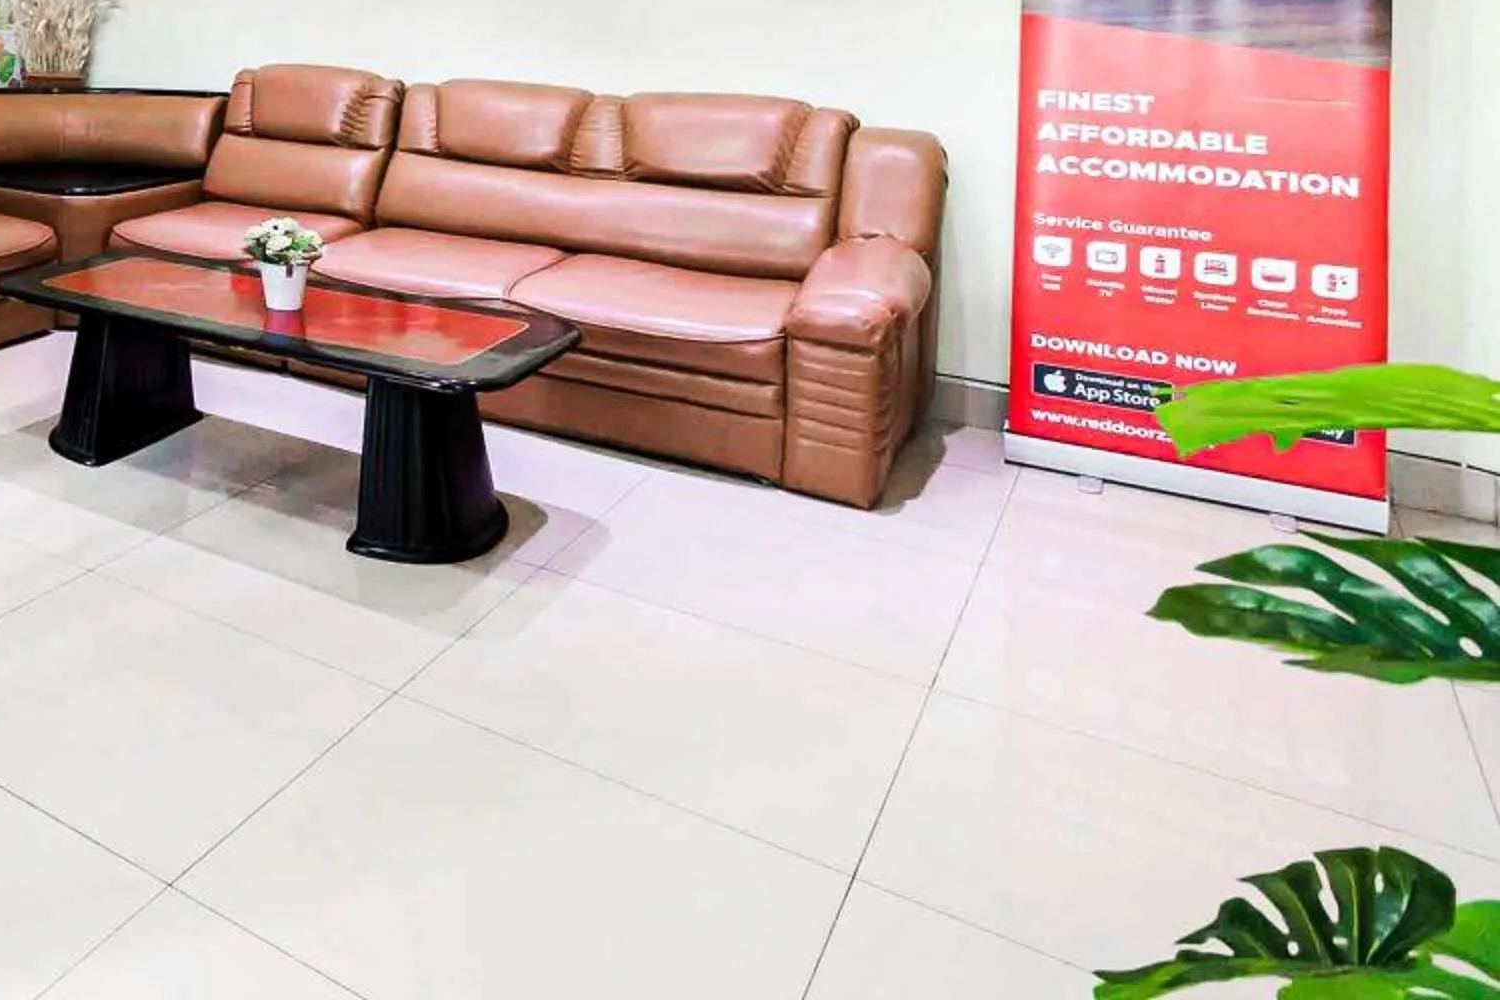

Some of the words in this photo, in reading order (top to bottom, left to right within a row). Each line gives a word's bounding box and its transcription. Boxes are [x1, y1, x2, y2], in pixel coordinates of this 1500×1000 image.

[1037, 89, 1154, 115] FINEST
[1037, 122, 1268, 156] AFFORDABLE
[1036, 155, 1361, 198] ACCOMMODATION
[1033, 212, 1103, 232] Service
[1108, 219, 1213, 242] Guarantee
[1030, 333, 1169, 365] DOWNLOAD
[1175, 353, 1237, 375] NOW
[1074, 384, 1110, 403] App
[1114, 388, 1161, 407] Store
[1031, 409, 1174, 442] www.reddoorz.
